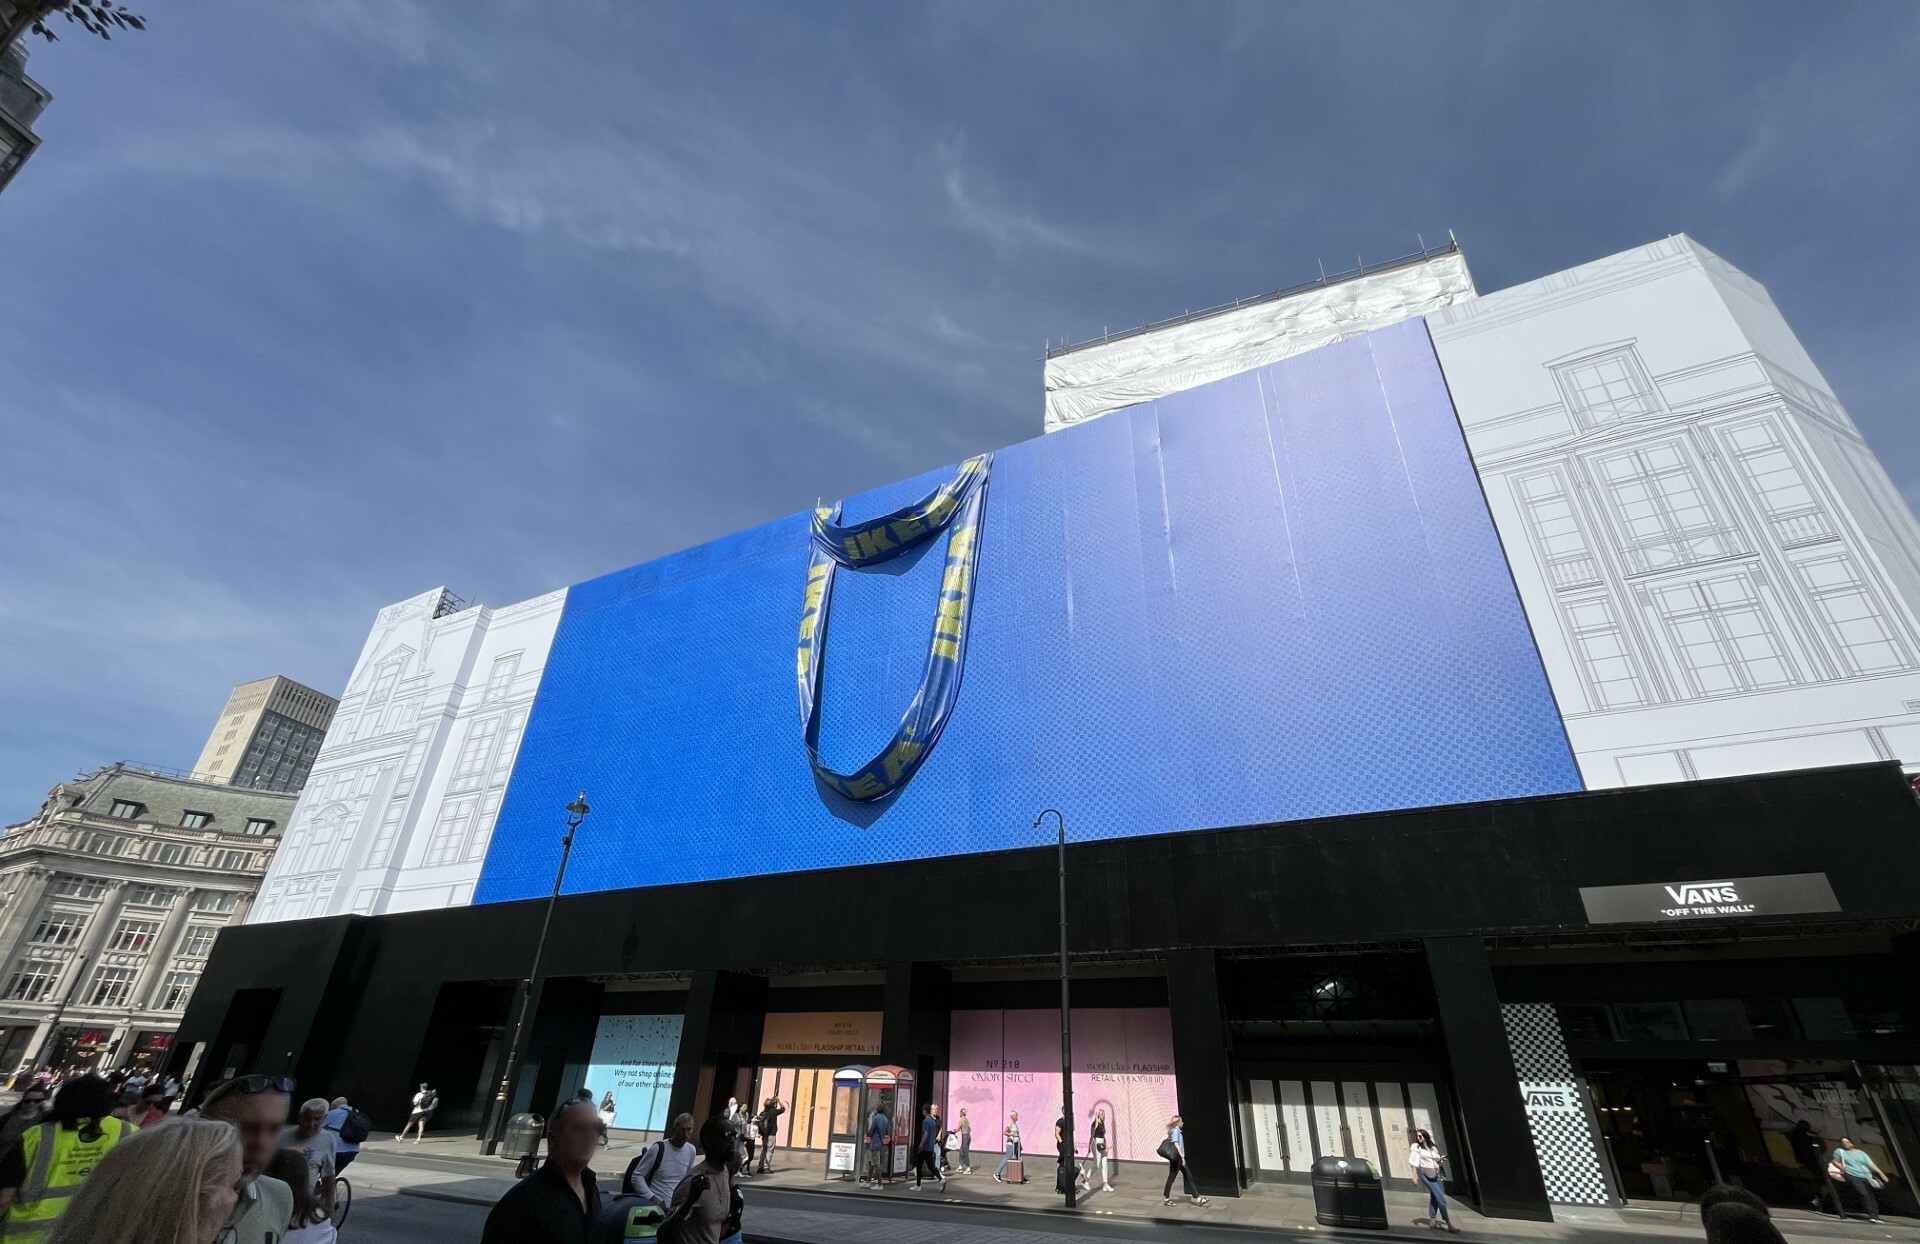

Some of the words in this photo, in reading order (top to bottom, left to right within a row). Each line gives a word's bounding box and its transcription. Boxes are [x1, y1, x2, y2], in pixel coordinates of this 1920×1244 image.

[843, 494, 957, 560] IKEA
[1663, 882, 1739, 905] VANS
[1691, 906, 1717, 915] THE
[814, 1043, 844, 1052] FLAGSHIP
[845, 1044, 866, 1052] RETAIL
[1001, 1060, 1020, 1069] 218
[1086, 1062, 1109, 1071] world
[1132, 1064, 1170, 1072] FLAGSHIP
[614, 1069, 627, 1078] Why
[638, 1070, 652, 1079] shop
[1091, 1074, 1116, 1082] RETAIL
[1116, 1074, 1165, 1085] opportunity
